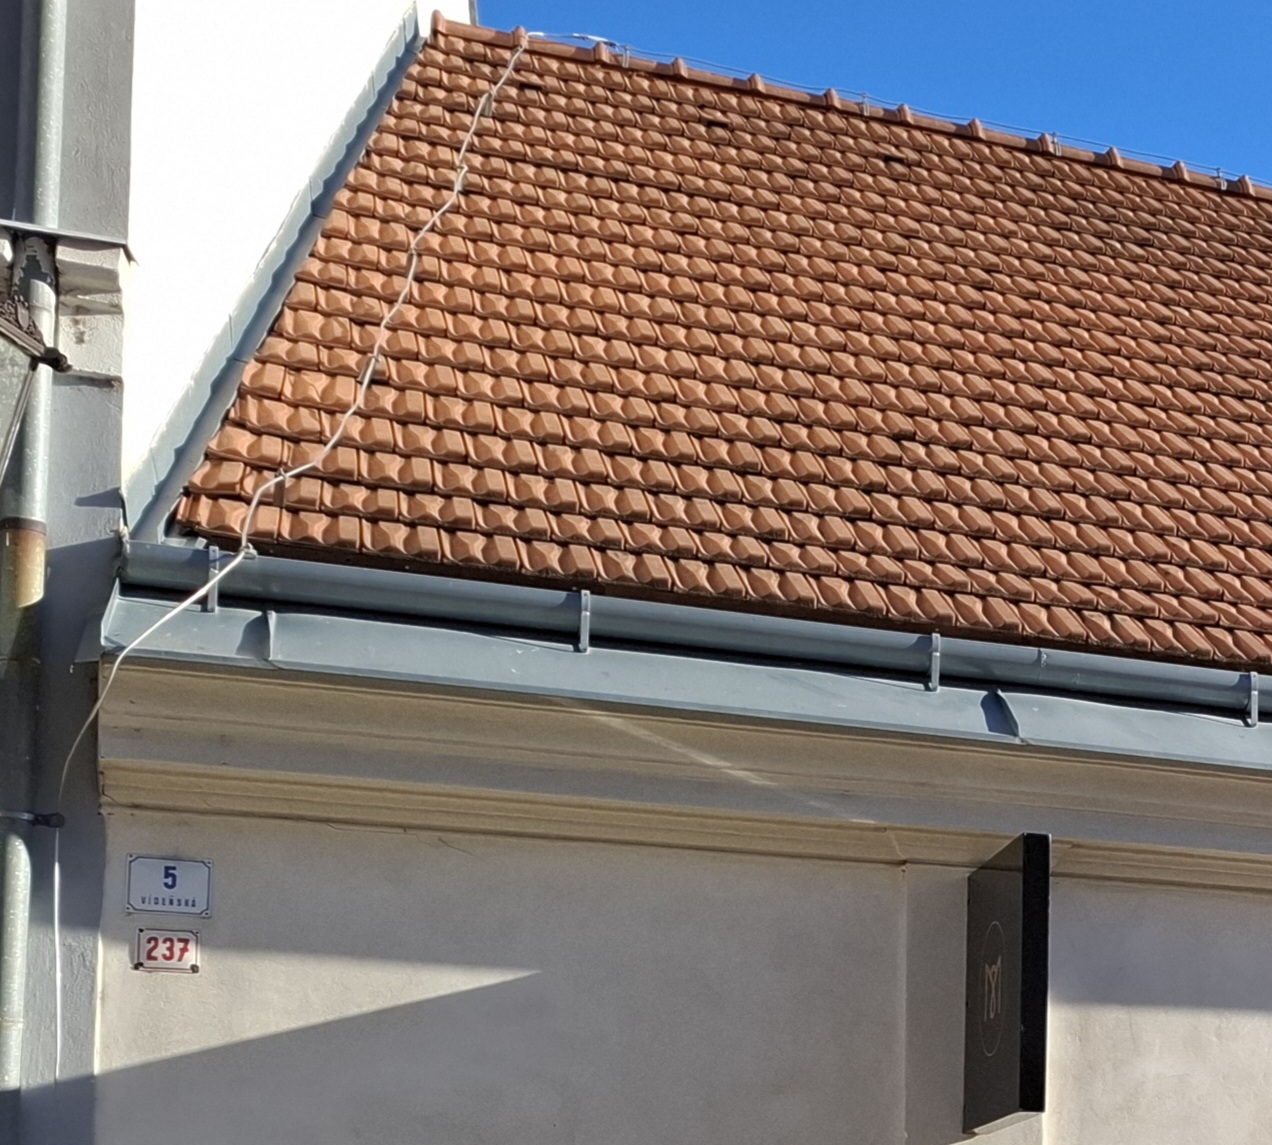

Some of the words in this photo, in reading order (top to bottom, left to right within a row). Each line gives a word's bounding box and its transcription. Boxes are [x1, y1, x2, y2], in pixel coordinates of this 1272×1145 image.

[163, 865, 178, 889] 5
[140, 895, 197, 908] VÍDEŇSKÁ
[145, 936, 191, 962] 237
